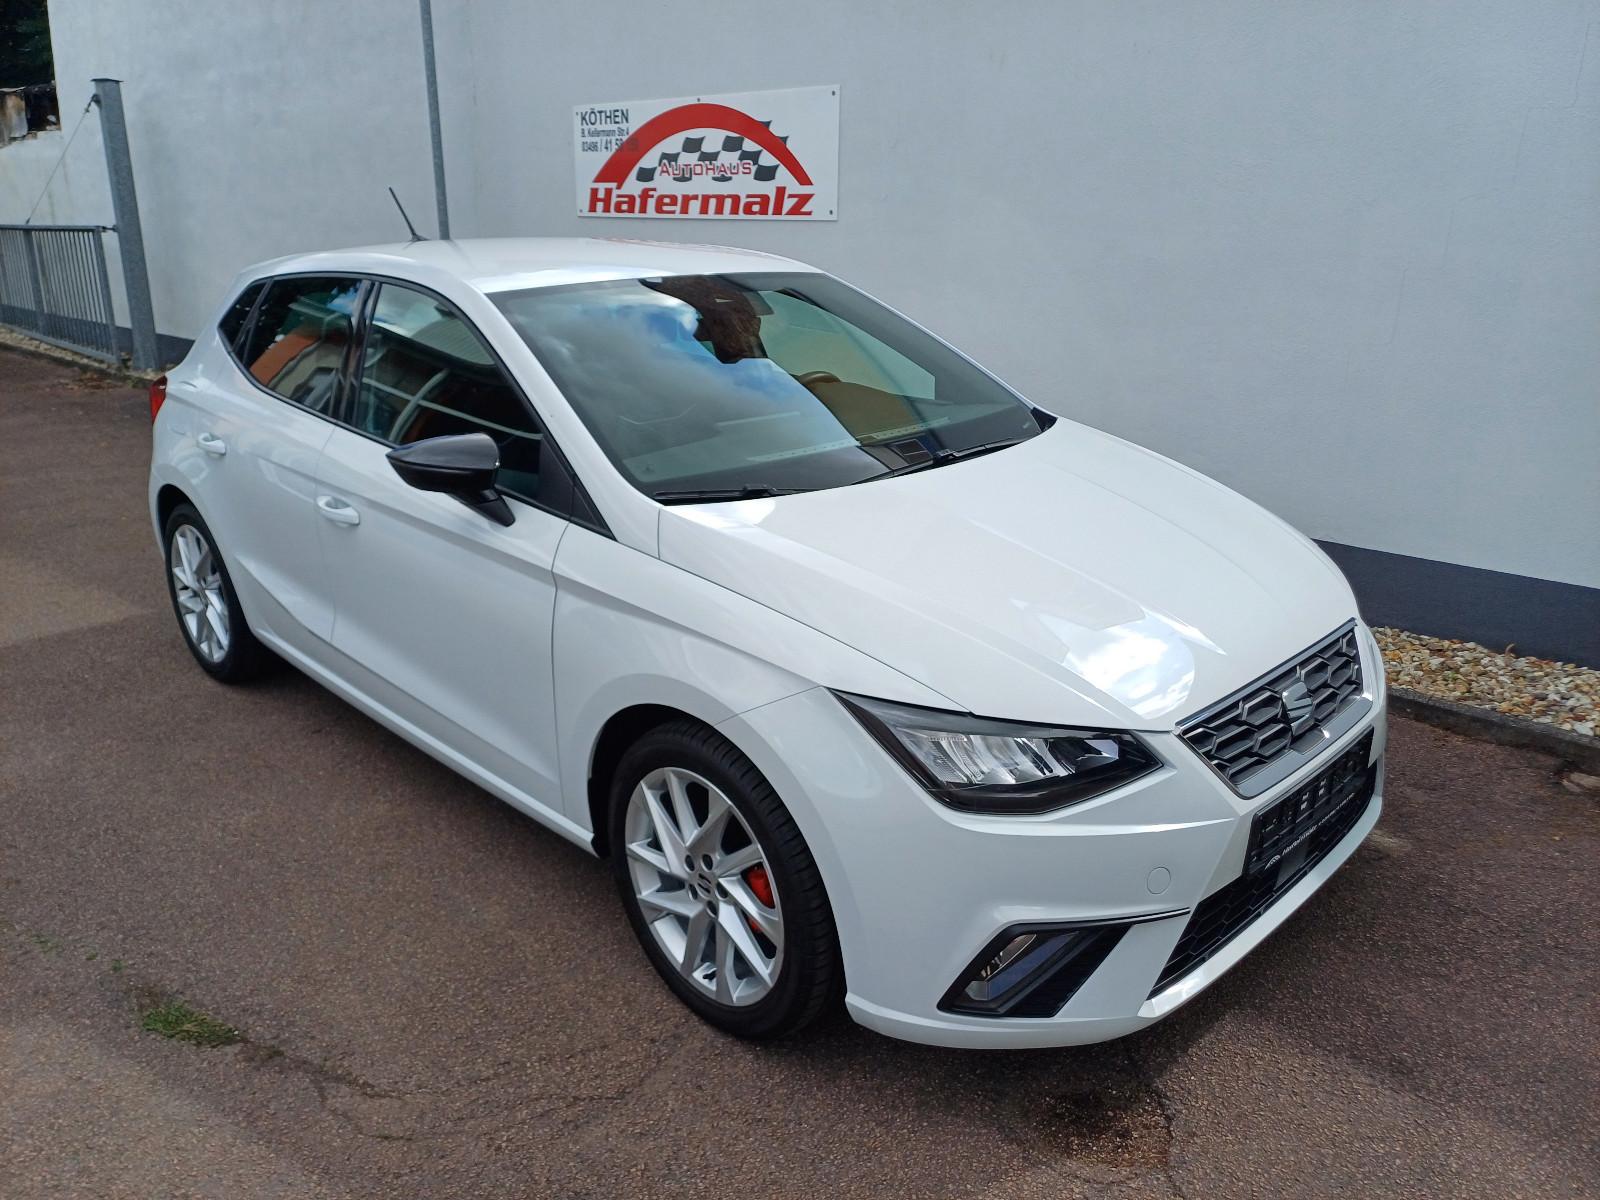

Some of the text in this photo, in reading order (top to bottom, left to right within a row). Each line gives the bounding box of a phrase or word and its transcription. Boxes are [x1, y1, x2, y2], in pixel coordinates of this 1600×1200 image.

[580, 107, 629, 126] KÖTHEN
[659, 161, 752, 176] AUTOHAUS
[588, 186, 815, 216] Hafermalz
